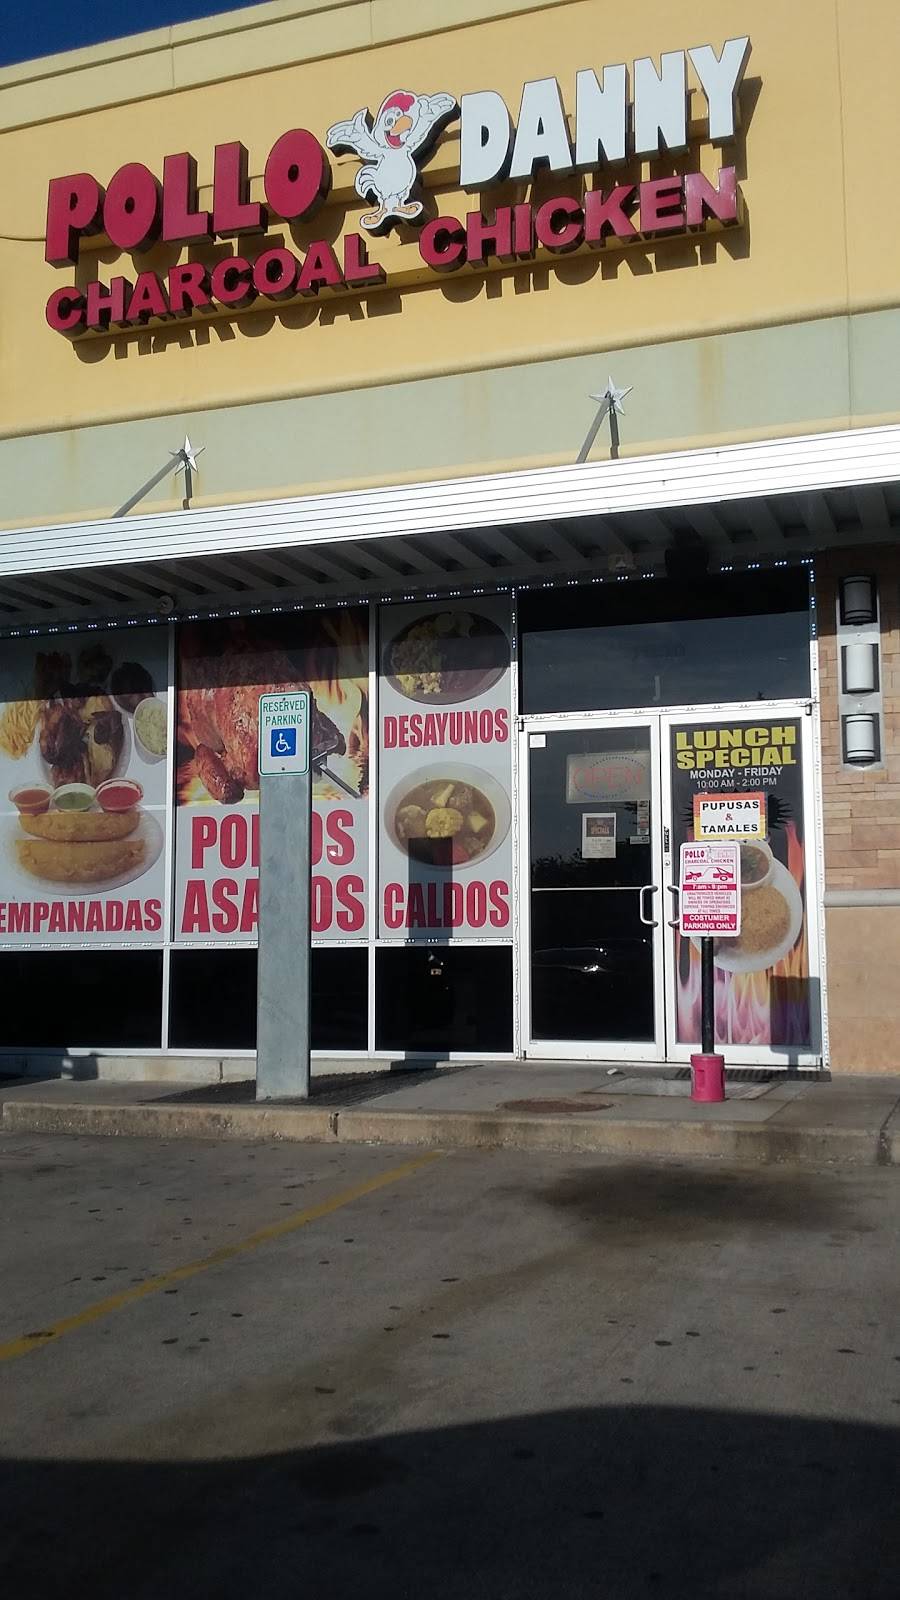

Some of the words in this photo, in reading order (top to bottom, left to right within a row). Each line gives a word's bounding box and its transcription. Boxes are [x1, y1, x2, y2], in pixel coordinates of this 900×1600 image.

[45, 128, 328, 265] POLLO
[460, 36, 751, 188] DANNY
[46, 233, 382, 331] CHARCOAL
[419, 166, 739, 266] CHICKEN
[263, 700, 306, 712] RESERVED
[265, 714, 302, 726] PARKING
[384, 708, 509, 749] DESAYUNOS
[676, 726, 796, 750] LUNCH
[676, 746, 797, 769] SPECIAL
[573, 766, 643, 791] OPEN
[690, 769, 735, 779] MONDAY
[744, 767, 783, 777] FRIDAY
[697, 780, 719, 788] 10:00
[702, 801, 759, 810] PUPUSAS
[725, 813, 733, 821] &
[702, 824, 758, 833] TAMALES
[685, 850, 705, 858] POLLO
[181, 874, 365, 933] ASAOS
[383, 880, 510, 929] CALDOS
[0, 899, 162, 933] EMPANADAS
